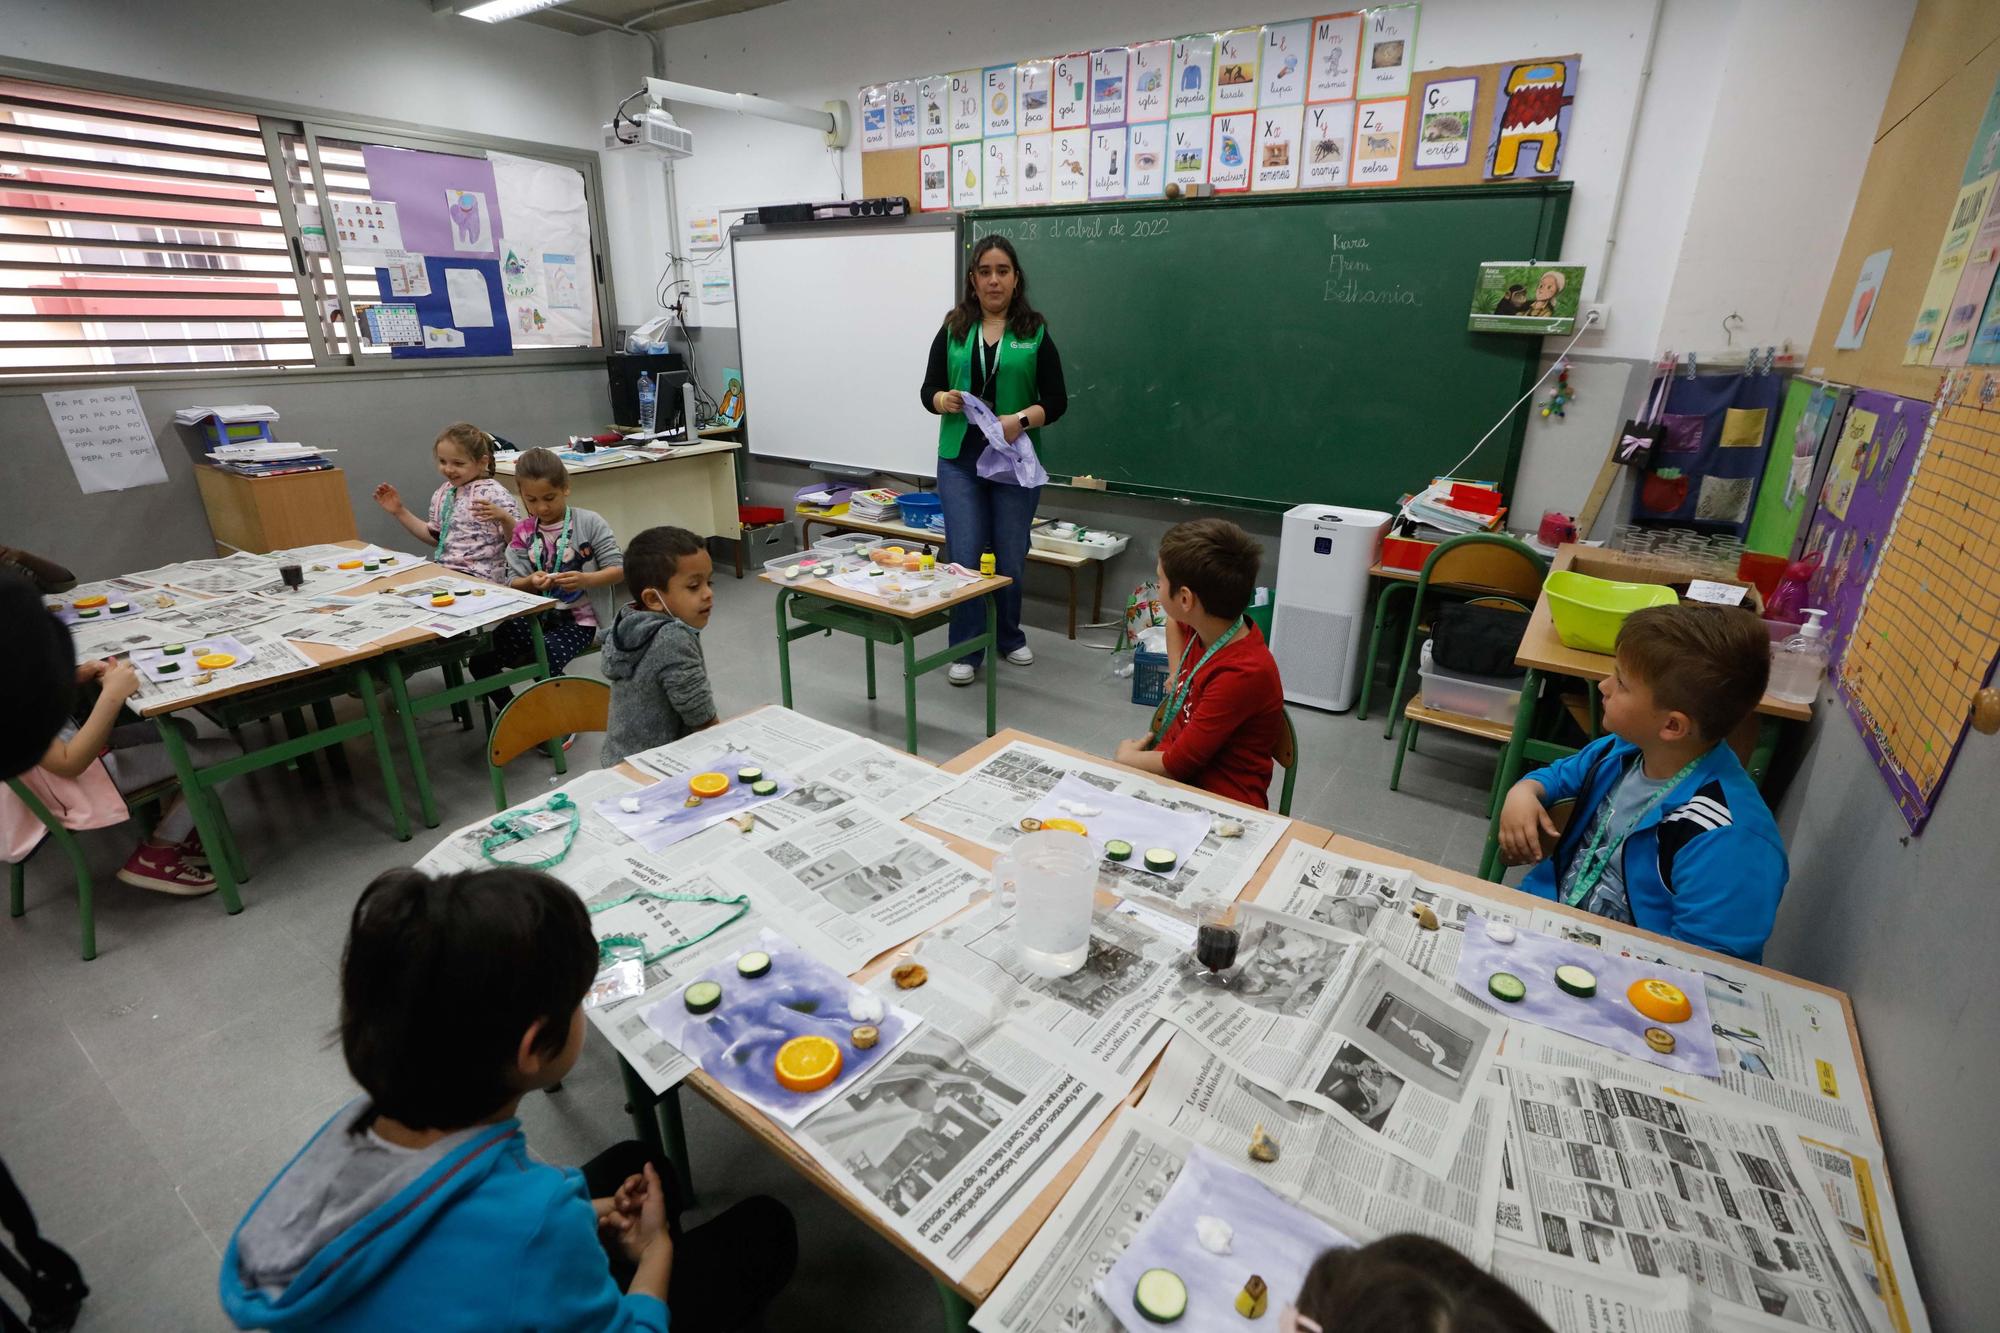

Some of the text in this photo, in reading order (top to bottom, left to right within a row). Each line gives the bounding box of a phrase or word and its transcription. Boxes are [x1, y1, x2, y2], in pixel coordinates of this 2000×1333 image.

[1019, 221, 1038, 241] 28
[1108, 218, 1126, 237] de
[1131, 218, 1170, 237] 2022
